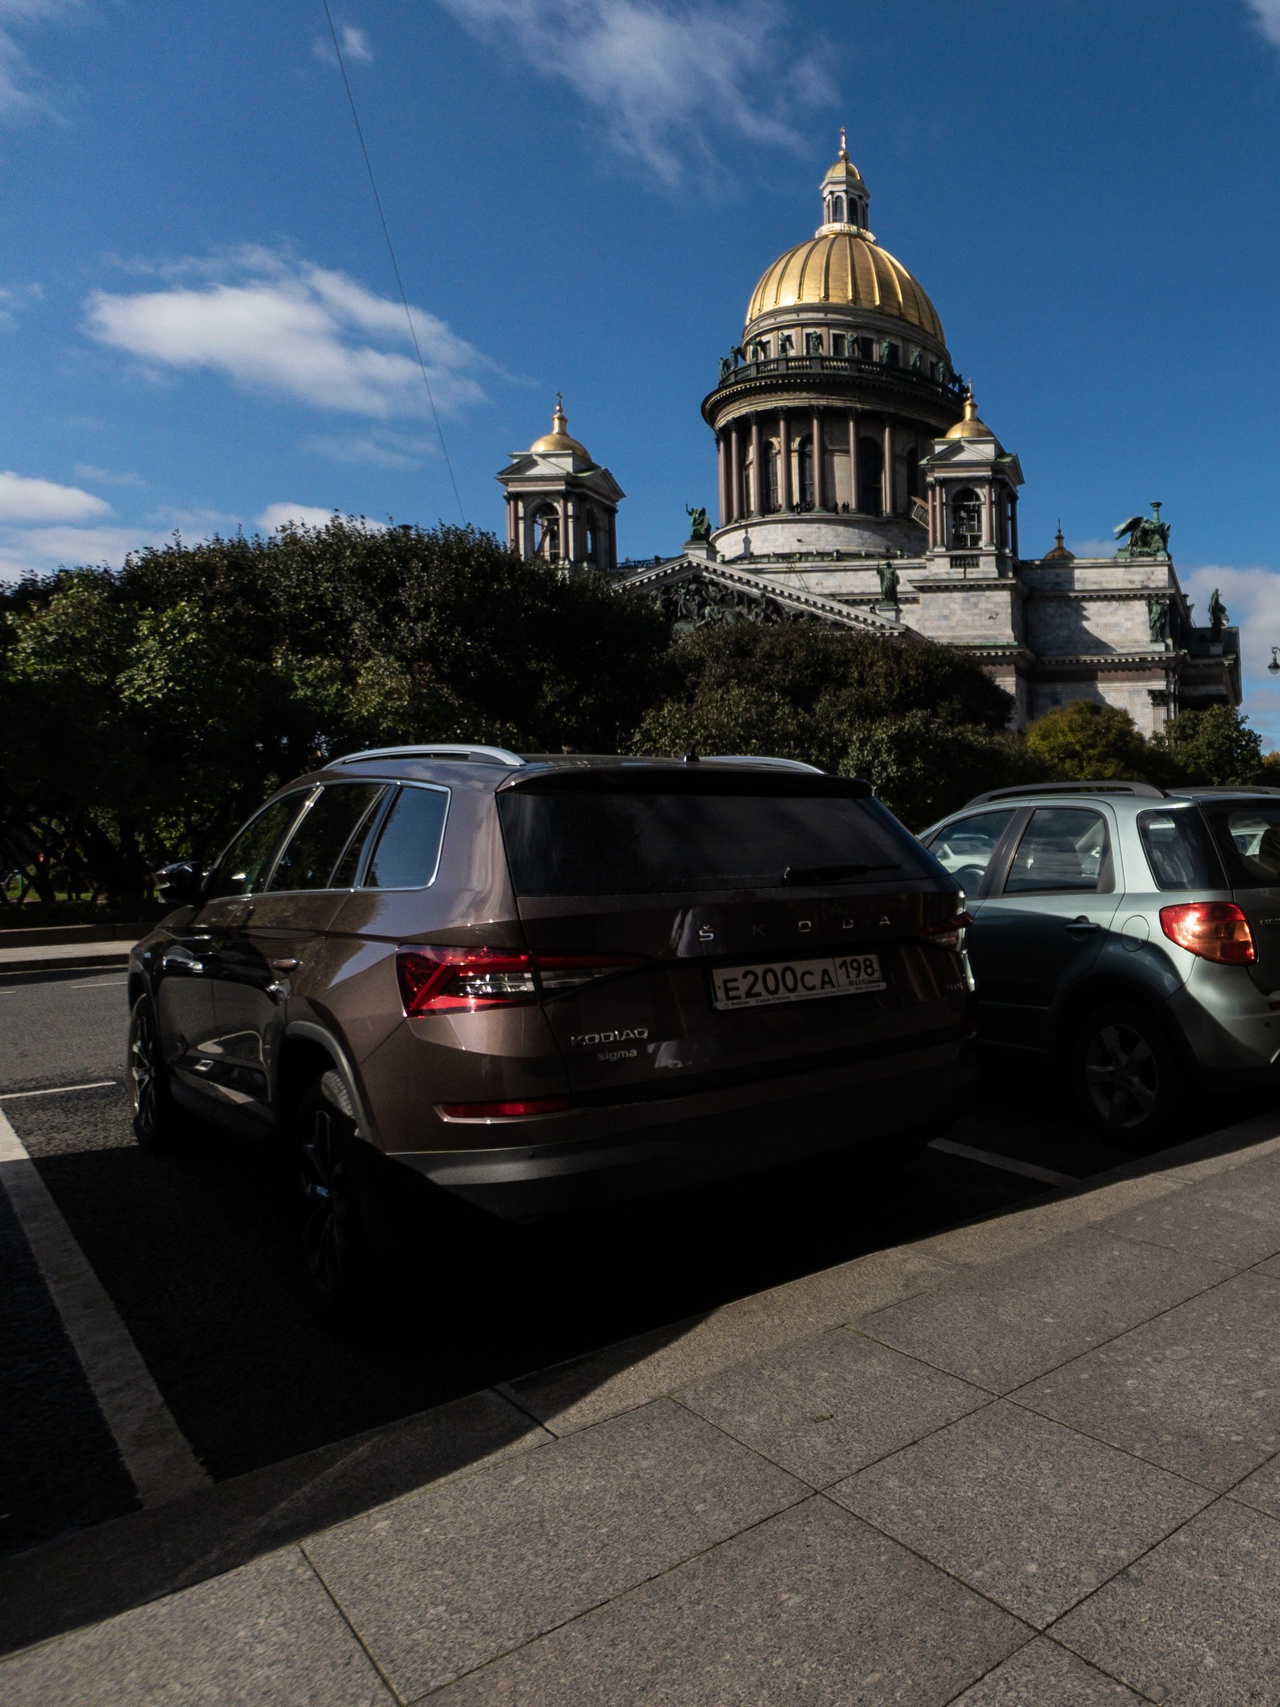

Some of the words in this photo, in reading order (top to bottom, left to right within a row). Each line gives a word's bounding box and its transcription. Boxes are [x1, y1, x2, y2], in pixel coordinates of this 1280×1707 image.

[722, 966, 836, 1000] Е200СА
[839, 957, 874, 978] 198
[571, 1028, 648, 1046] KODIAQ
[597, 1049, 638, 1062] sigma
